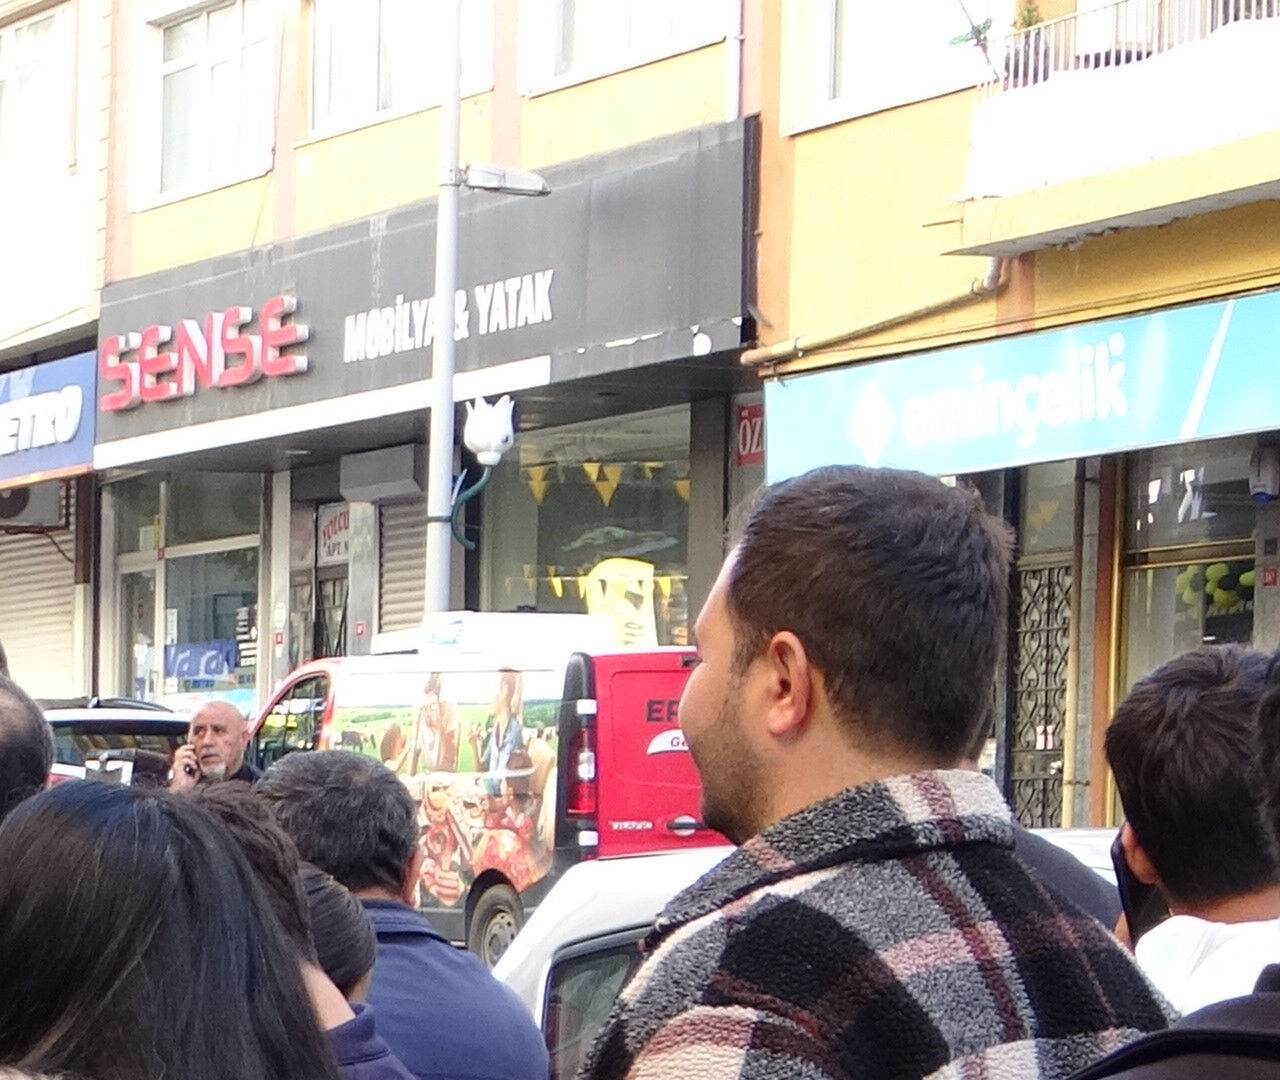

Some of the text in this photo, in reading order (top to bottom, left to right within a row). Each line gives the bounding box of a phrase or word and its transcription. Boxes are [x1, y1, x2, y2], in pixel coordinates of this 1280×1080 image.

[99, 294, 309, 411] SENSE
[454, 289, 470, 341] &
[475, 269, 554, 335] YATAK
[903, 332, 1129, 448] eminçelik
